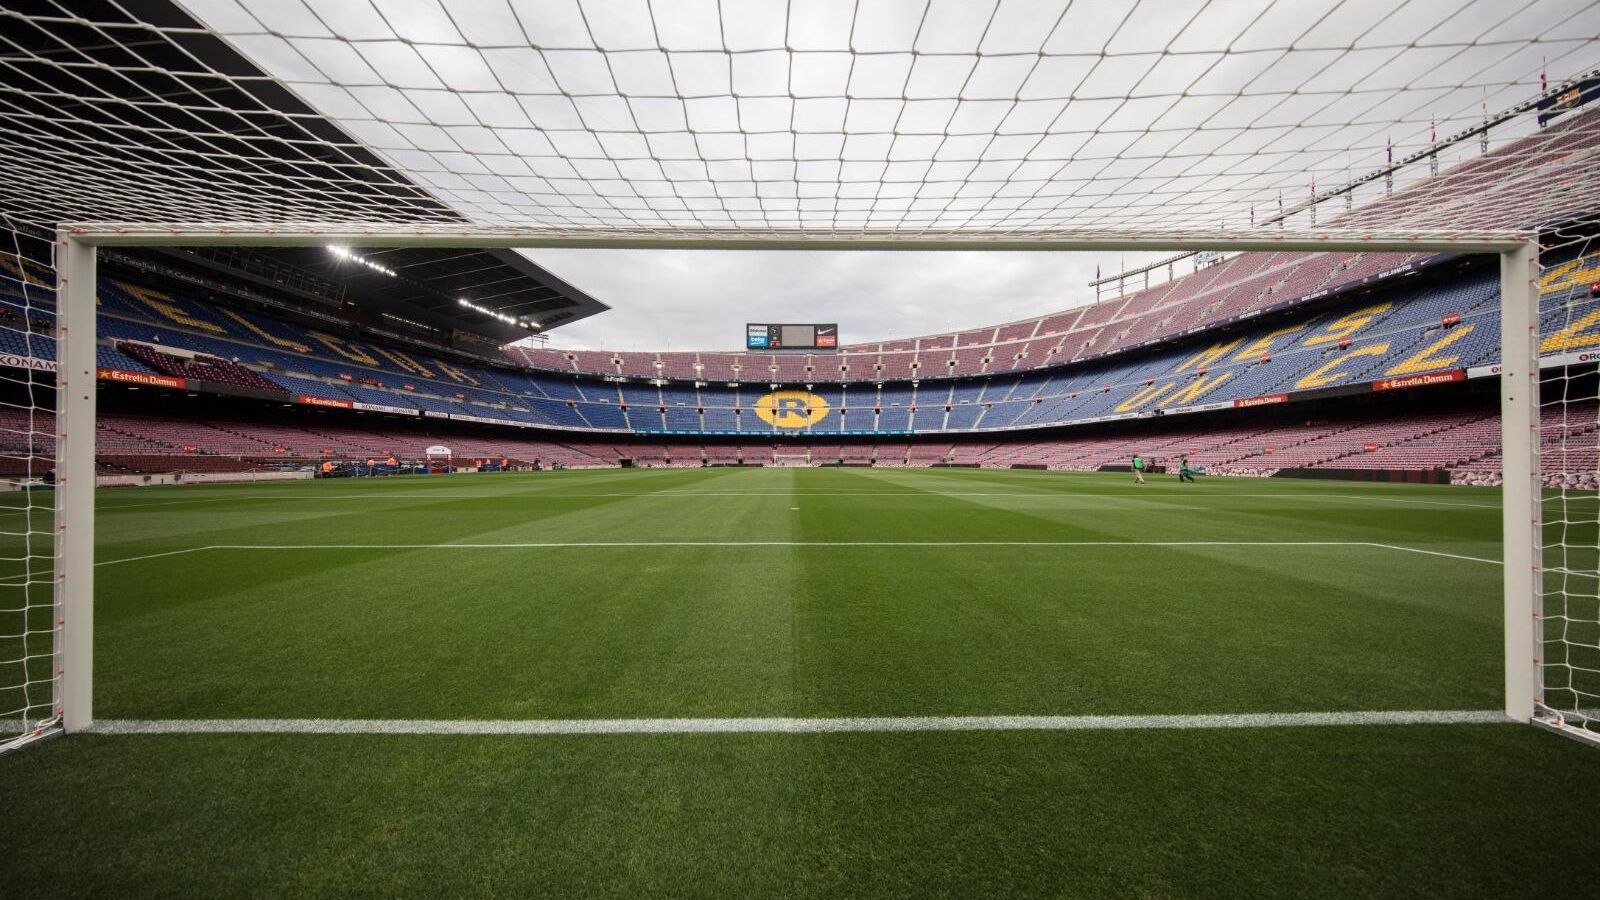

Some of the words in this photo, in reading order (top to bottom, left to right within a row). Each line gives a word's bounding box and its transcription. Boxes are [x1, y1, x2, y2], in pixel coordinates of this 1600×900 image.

[112, 370, 148, 383] Estrella
[150, 376, 177, 387] Damm
[1390, 378, 1422, 388] Estrella
[1423, 374, 1453, 384] Damm
[778, 398, 808, 418] R
